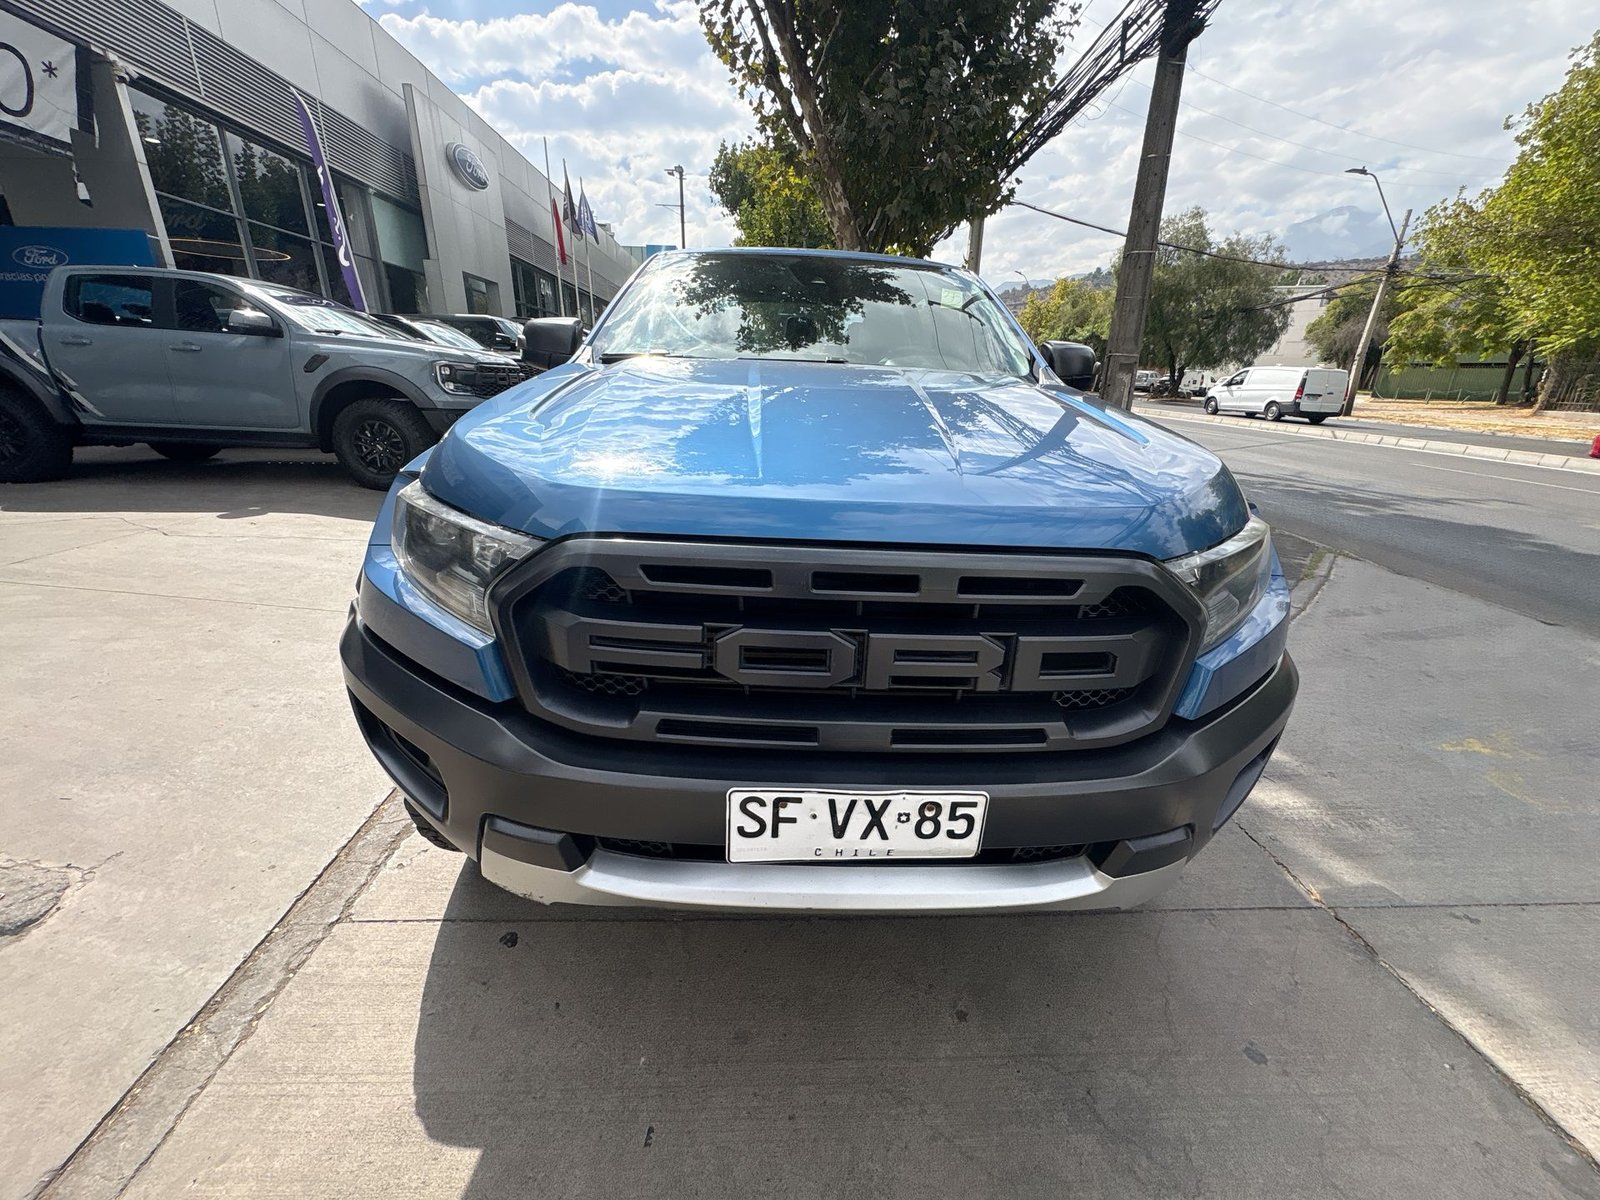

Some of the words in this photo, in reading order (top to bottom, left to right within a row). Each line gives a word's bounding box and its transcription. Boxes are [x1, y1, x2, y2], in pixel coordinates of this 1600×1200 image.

[24, 248, 58, 265] Ford
[542, 612, 1149, 692] FORD
[736, 796, 803, 839] SF
[827, 798, 893, 841] VX
[913, 800, 979, 840] 85
[814, 847, 895, 858] CHILE
